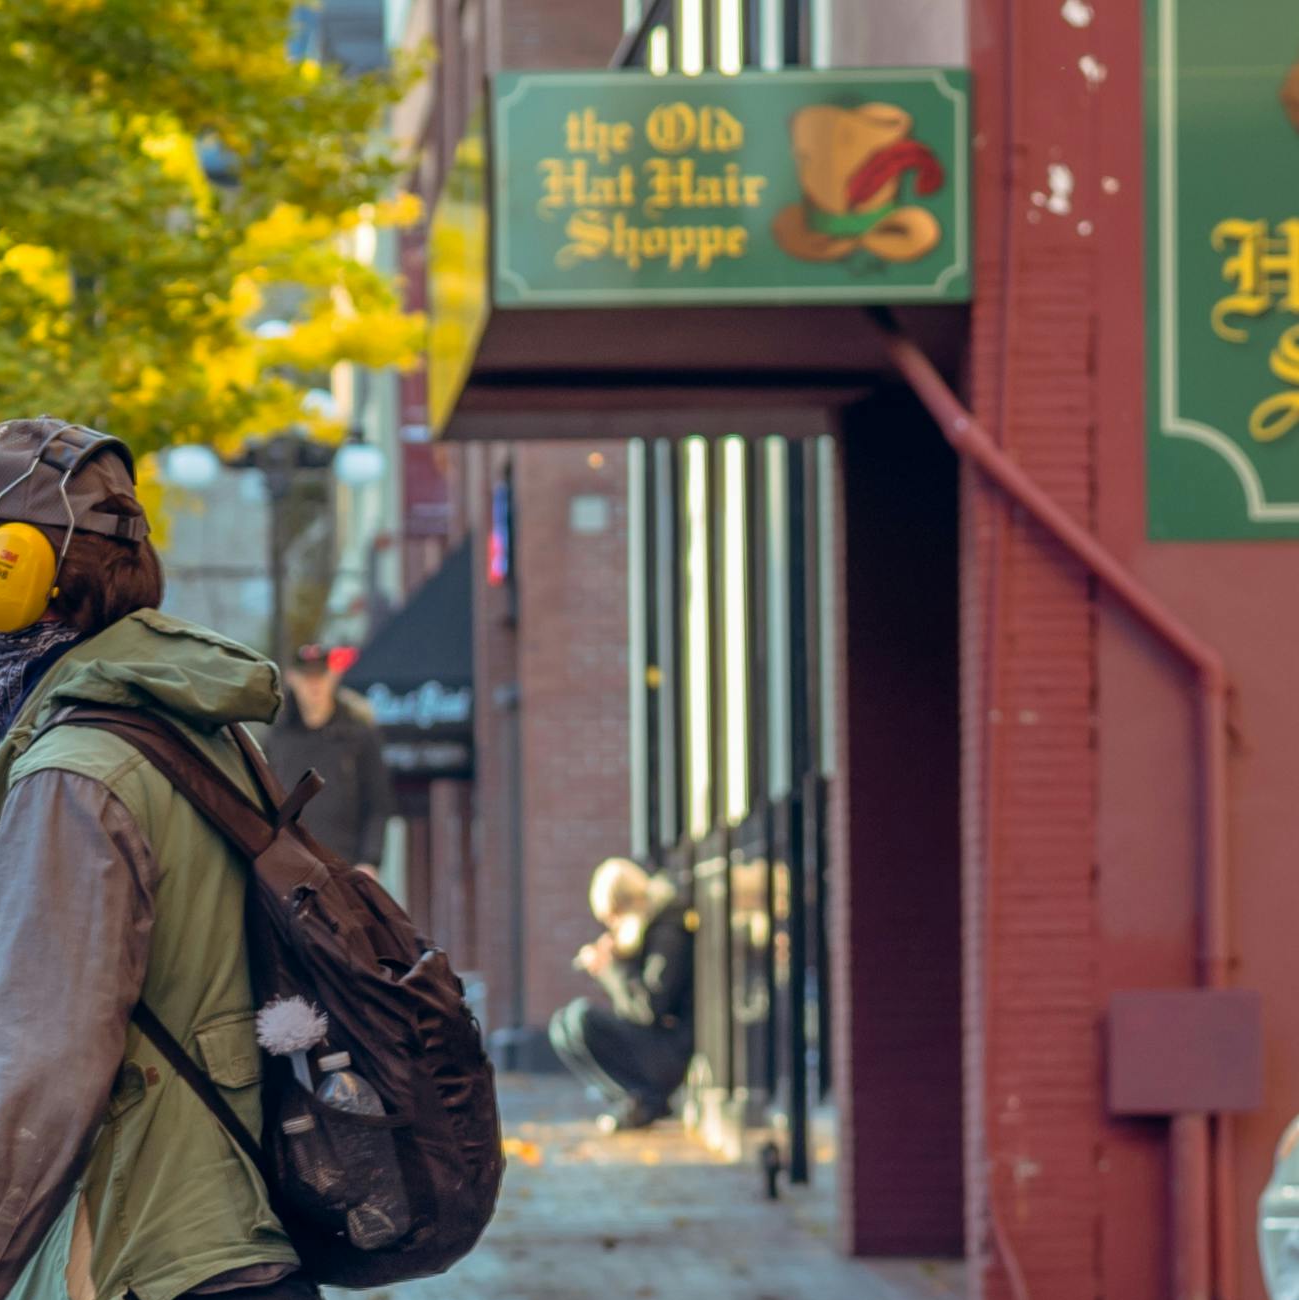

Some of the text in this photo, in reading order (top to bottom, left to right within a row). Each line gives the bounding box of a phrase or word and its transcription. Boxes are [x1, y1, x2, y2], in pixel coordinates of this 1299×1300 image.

[565, 101, 744, 165] the Old
[537, 158, 768, 222] Hat Hair
[555, 209, 748, 271] Shoppe
